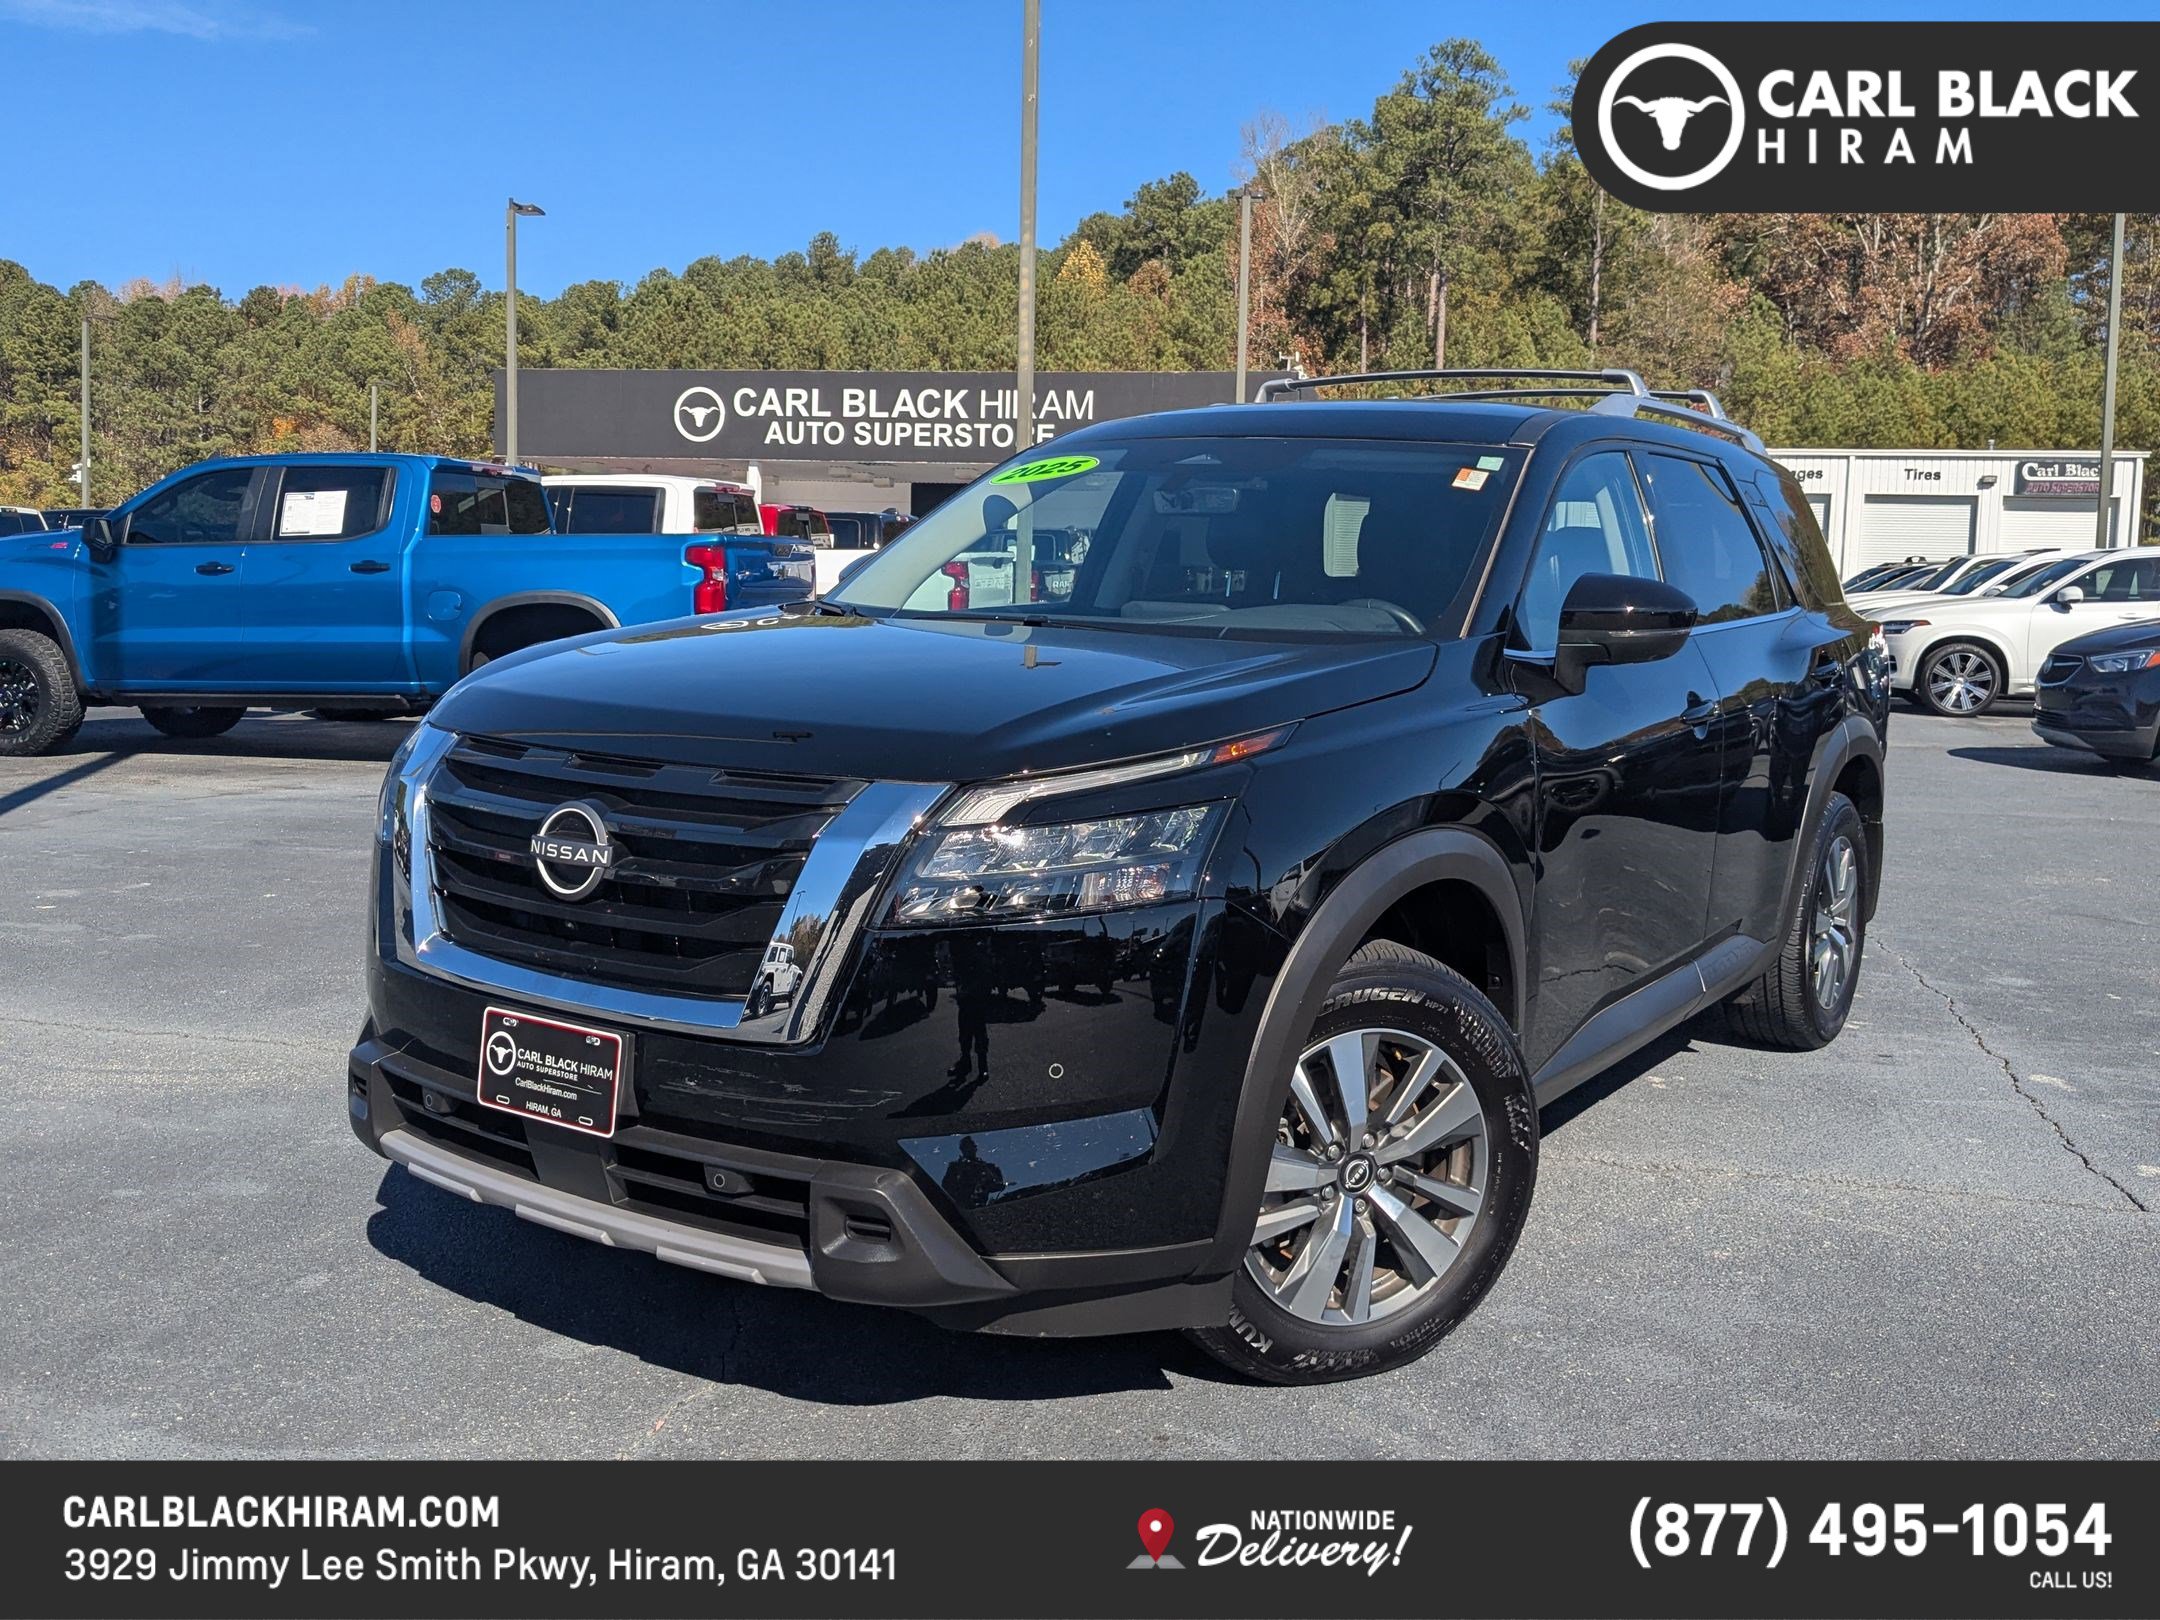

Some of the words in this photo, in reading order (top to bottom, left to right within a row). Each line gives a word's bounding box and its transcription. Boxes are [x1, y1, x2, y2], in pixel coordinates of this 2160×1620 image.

[733, 387, 832, 418] CARL
[842, 388, 969, 419] BLACK
[980, 389, 1094, 420] HIAM
[763, 420, 845, 446] AUTO
[853, 422, 1056, 448] SUPERSTOE
[999, 459, 1091, 482] 2025
[1904, 468, 1942, 481] Tires
[2021, 462, 2060, 481] Carl
[2064, 463, 2101, 477] Blac
[530, 838, 609, 865] NISSAN
[1424, 999, 1450, 1015] HP71
[516, 1060, 535, 1072] AUTO
[535, 1064, 578, 1082] SUPERSTORE
[517, 1048, 543, 1065] CARL
[544, 1054, 578, 1073] BLACK
[579, 1063, 613, 1081] HIRAM
[515, 1076, 578, 1101] CarlBlackHiram.com
[525, 1100, 550, 1117] HIRAM,
[550, 1106, 562, 1118] GA
